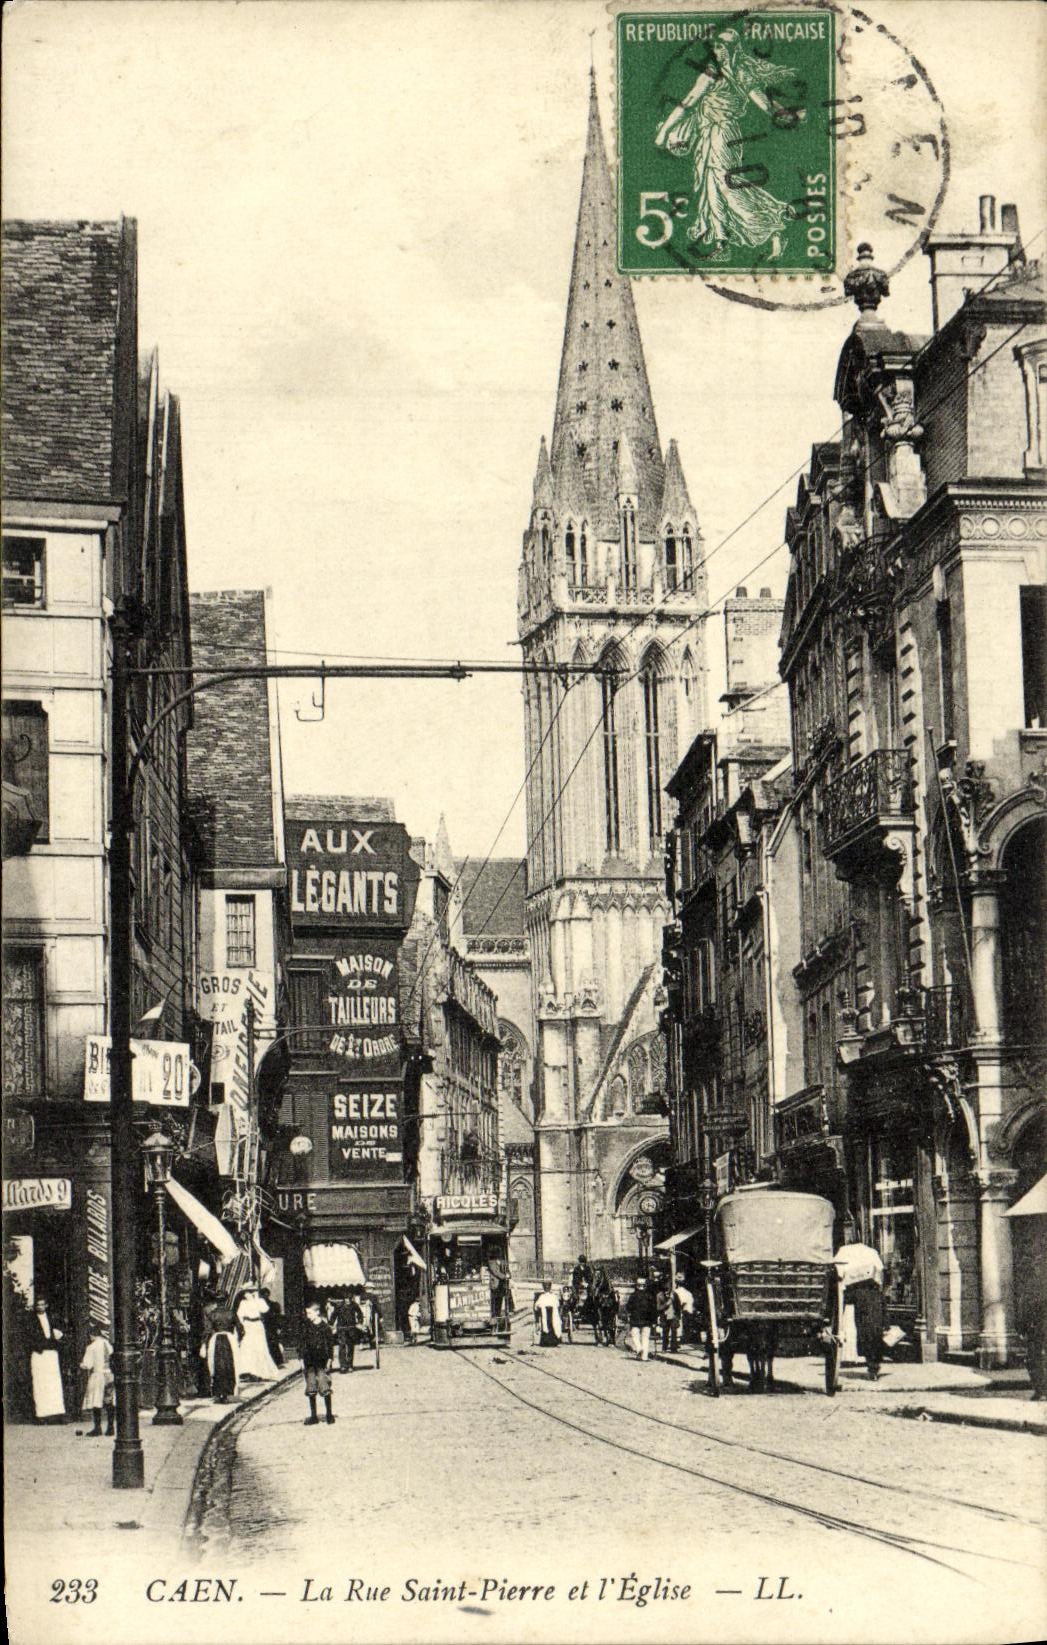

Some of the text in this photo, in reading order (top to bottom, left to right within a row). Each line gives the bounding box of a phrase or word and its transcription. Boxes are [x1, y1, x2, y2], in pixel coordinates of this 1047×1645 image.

[301, 828, 378, 856] AUX
[291, 864, 399, 916] LÉGANTS
[335, 953, 395, 981] MAISON
[200, 976, 242, 996] GROS
[347, 979, 378, 990] DE
[328, 996, 397, 1026] TAILLEURS
[363, 1034, 400, 1058] ORDRE
[333, 1093, 398, 1119] SEIZE
[331, 1125, 399, 1140] MAISONS
[341, 1147, 387, 1160] VENTE
[86, 1188, 108, 1263] BILLARDS
[87, 1265, 111, 1326] QUATRE
